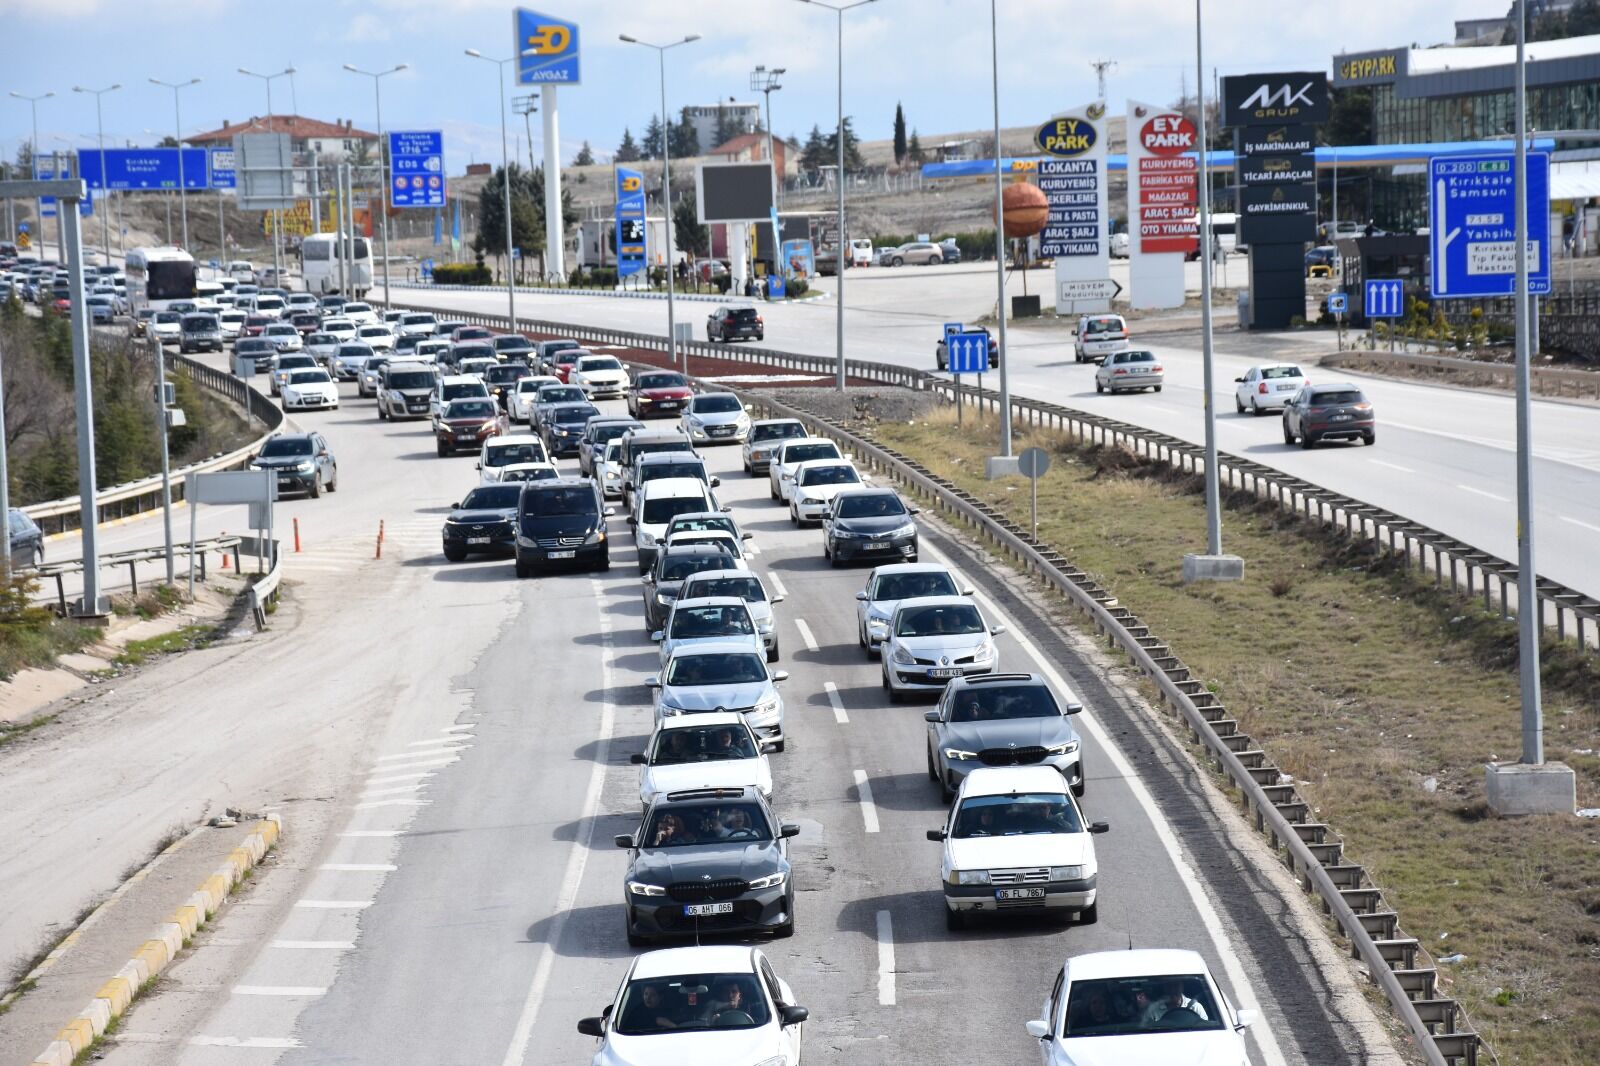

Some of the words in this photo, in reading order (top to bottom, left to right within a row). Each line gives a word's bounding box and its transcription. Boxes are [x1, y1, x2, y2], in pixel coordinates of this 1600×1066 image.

[532, 70, 568, 80] AYGAZ
[1255, 107, 1299, 117] GRUP
[1056, 120, 1078, 135] EY
[1153, 117, 1182, 132] EY
[1045, 134, 1090, 150] PARK
[1144, 132, 1192, 147] PARK
[1245, 143, 1254, 153] İŞ
[1255, 140, 1310, 152] MAKİNALARI
[398, 160, 418, 169] EDS
[1042, 161, 1094, 173] LOKANTA
[1142, 158, 1194, 170] KURUYEMİŞ
[1174, 174, 1194, 185] SATIŞ
[1244, 171, 1272, 181] TİCARİ
[1274, 171, 1312, 181] ARAÇLAR
[1450, 175, 1513, 186] Kırıkkale
[1040, 177, 1096, 189] KURUYEMİŞ
[1047, 193, 1097, 205] EKERLEME
[1148, 191, 1189, 202] MAĞAZASI
[1451, 188, 1507, 198] Samsun
[1145, 208, 1169, 219] ARAÇ
[1171, 207, 1195, 219] ŞARJ
[1247, 202, 1309, 212] GAYRİMENKUL
[1072, 210, 1097, 221] PASTA
[1045, 228, 1070, 240] ARAÇ
[1072, 226, 1095, 240] ŞARJ
[1142, 224, 1159, 235] OTO
[1162, 223, 1198, 233] YIKAMA
[1042, 245, 1060, 255] OTO
[1063, 243, 1098, 254] YIKAMA
[1000, 890, 1009, 899] 06
[1013, 889, 1022, 898] FL
[1026, 888, 1044, 897] 7867
[688, 906, 698, 915] 06
[702, 904, 715, 914] AHT
[718, 903, 732, 912] 066
